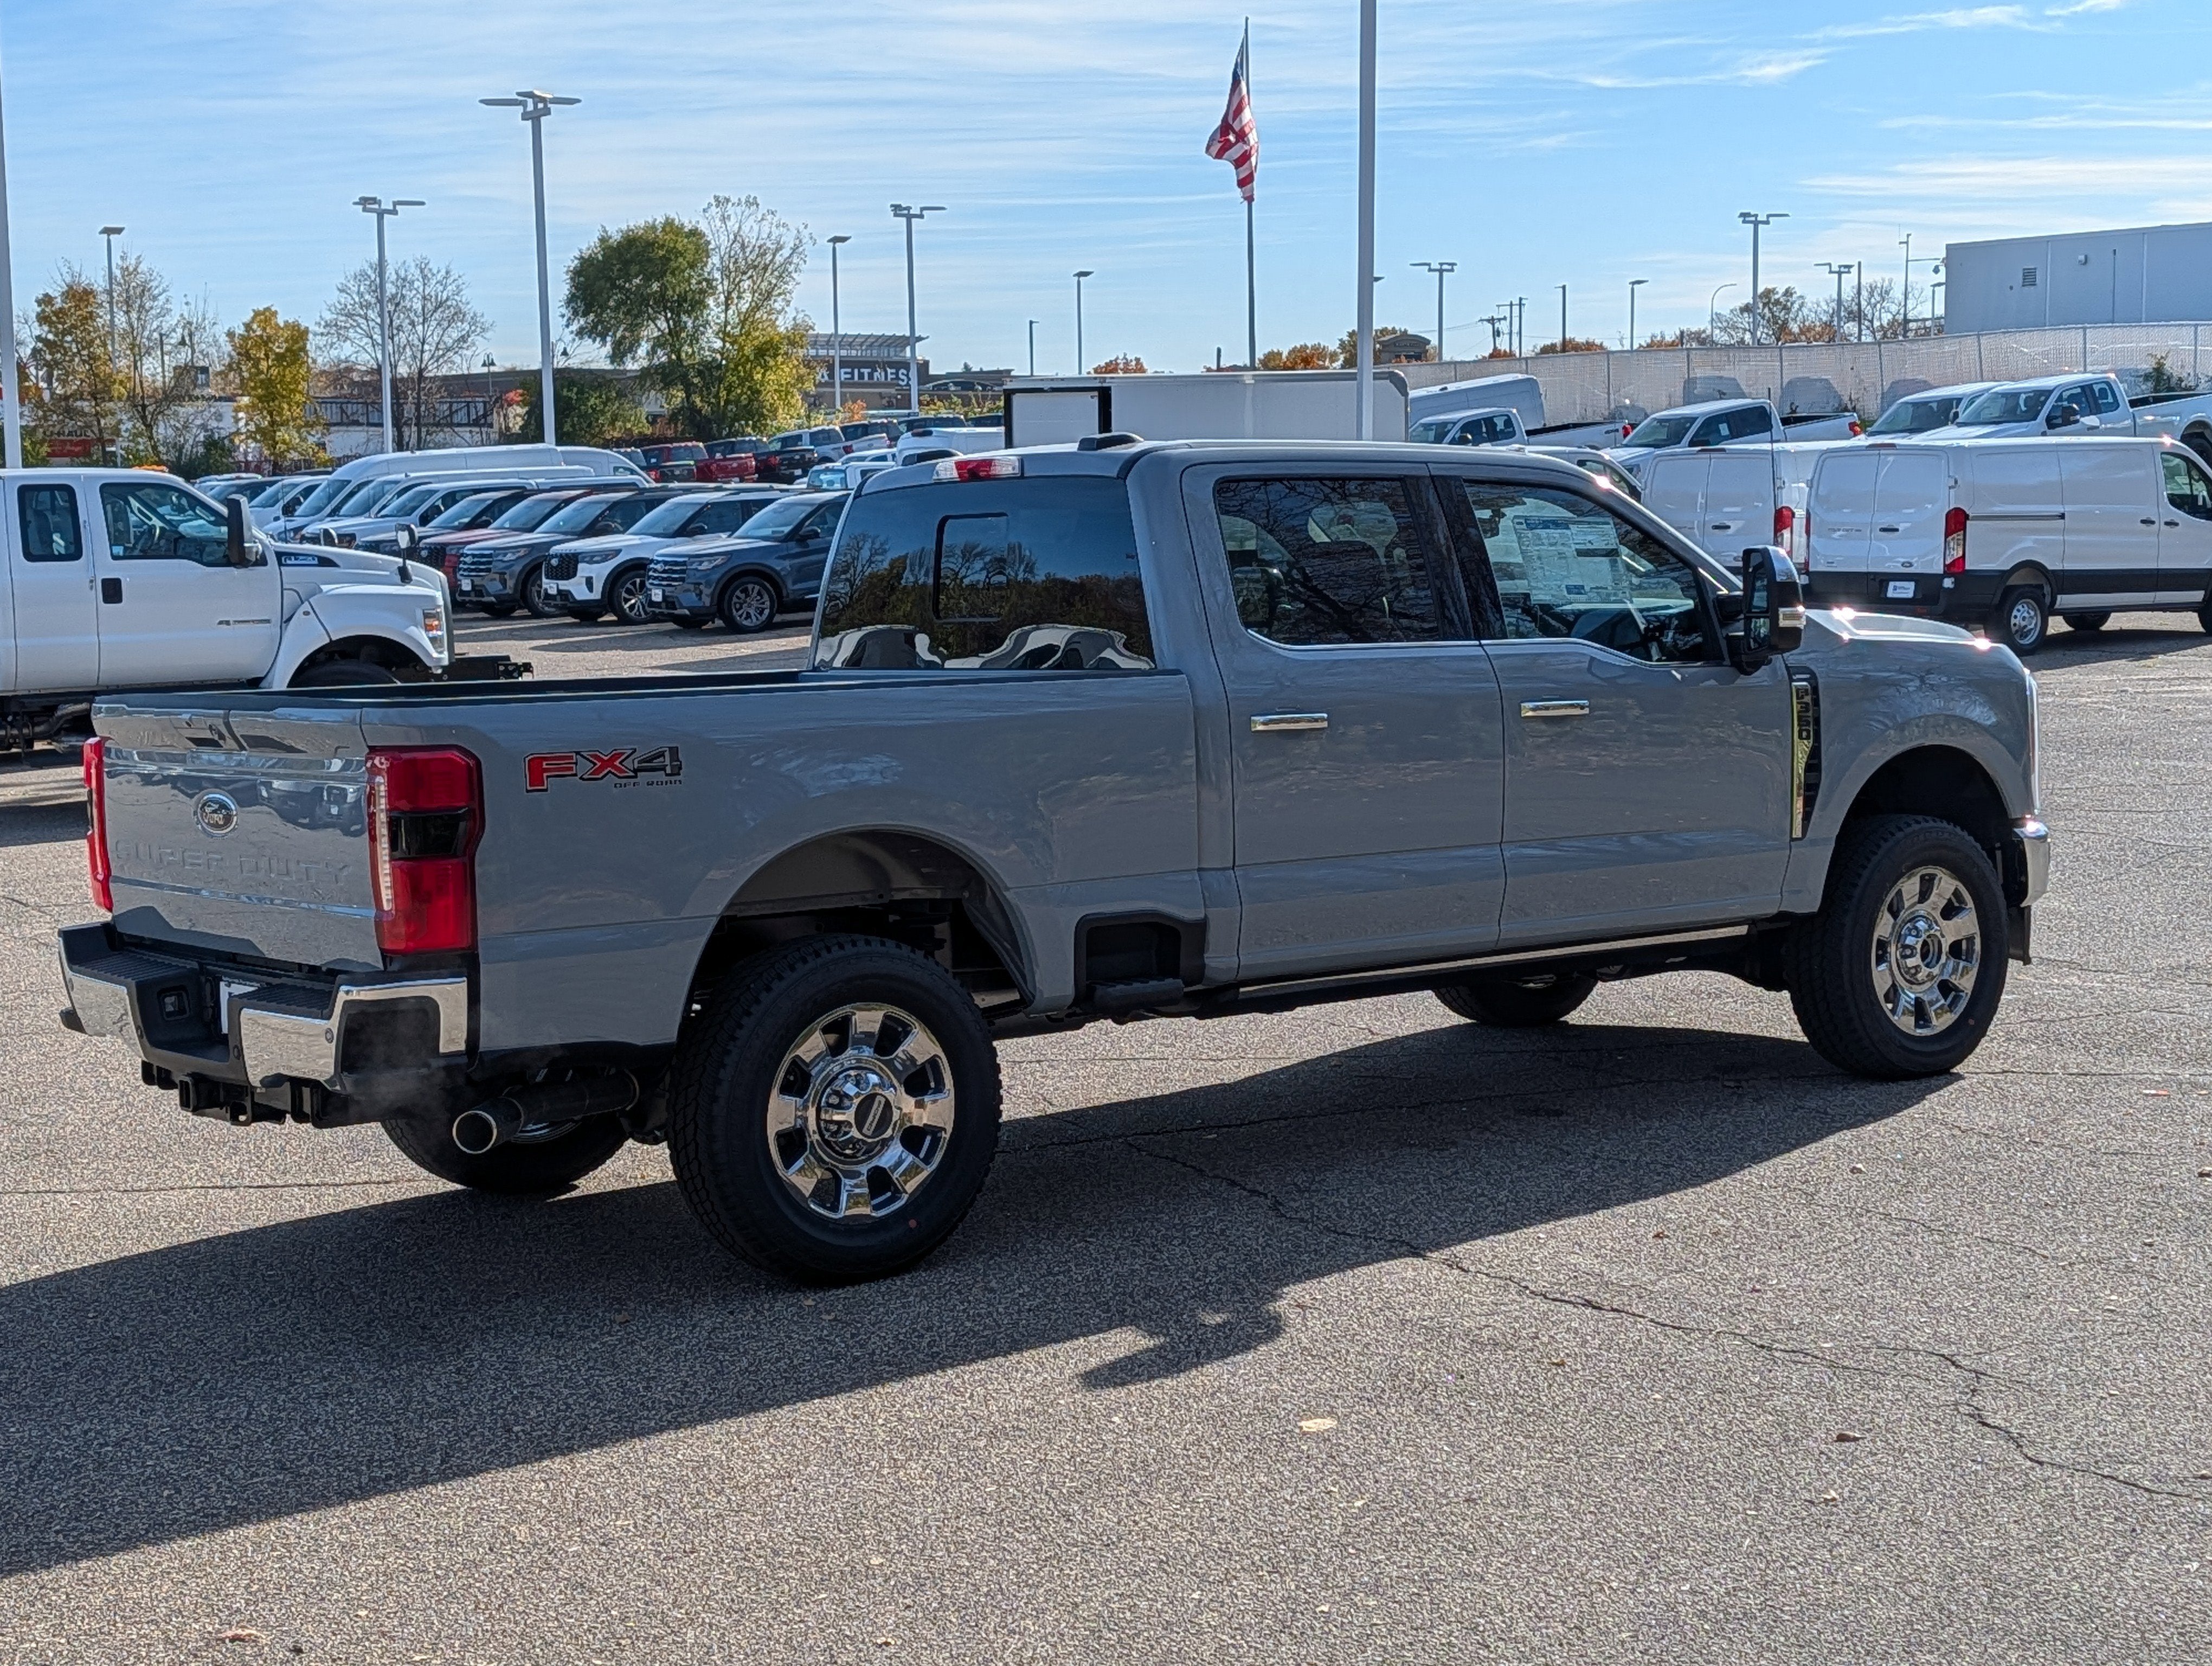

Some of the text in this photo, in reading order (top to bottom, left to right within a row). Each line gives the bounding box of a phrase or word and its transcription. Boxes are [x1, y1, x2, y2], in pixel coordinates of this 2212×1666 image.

[524, 746, 682, 793] FX4
[114, 838, 351, 885] SUPER DUTY
